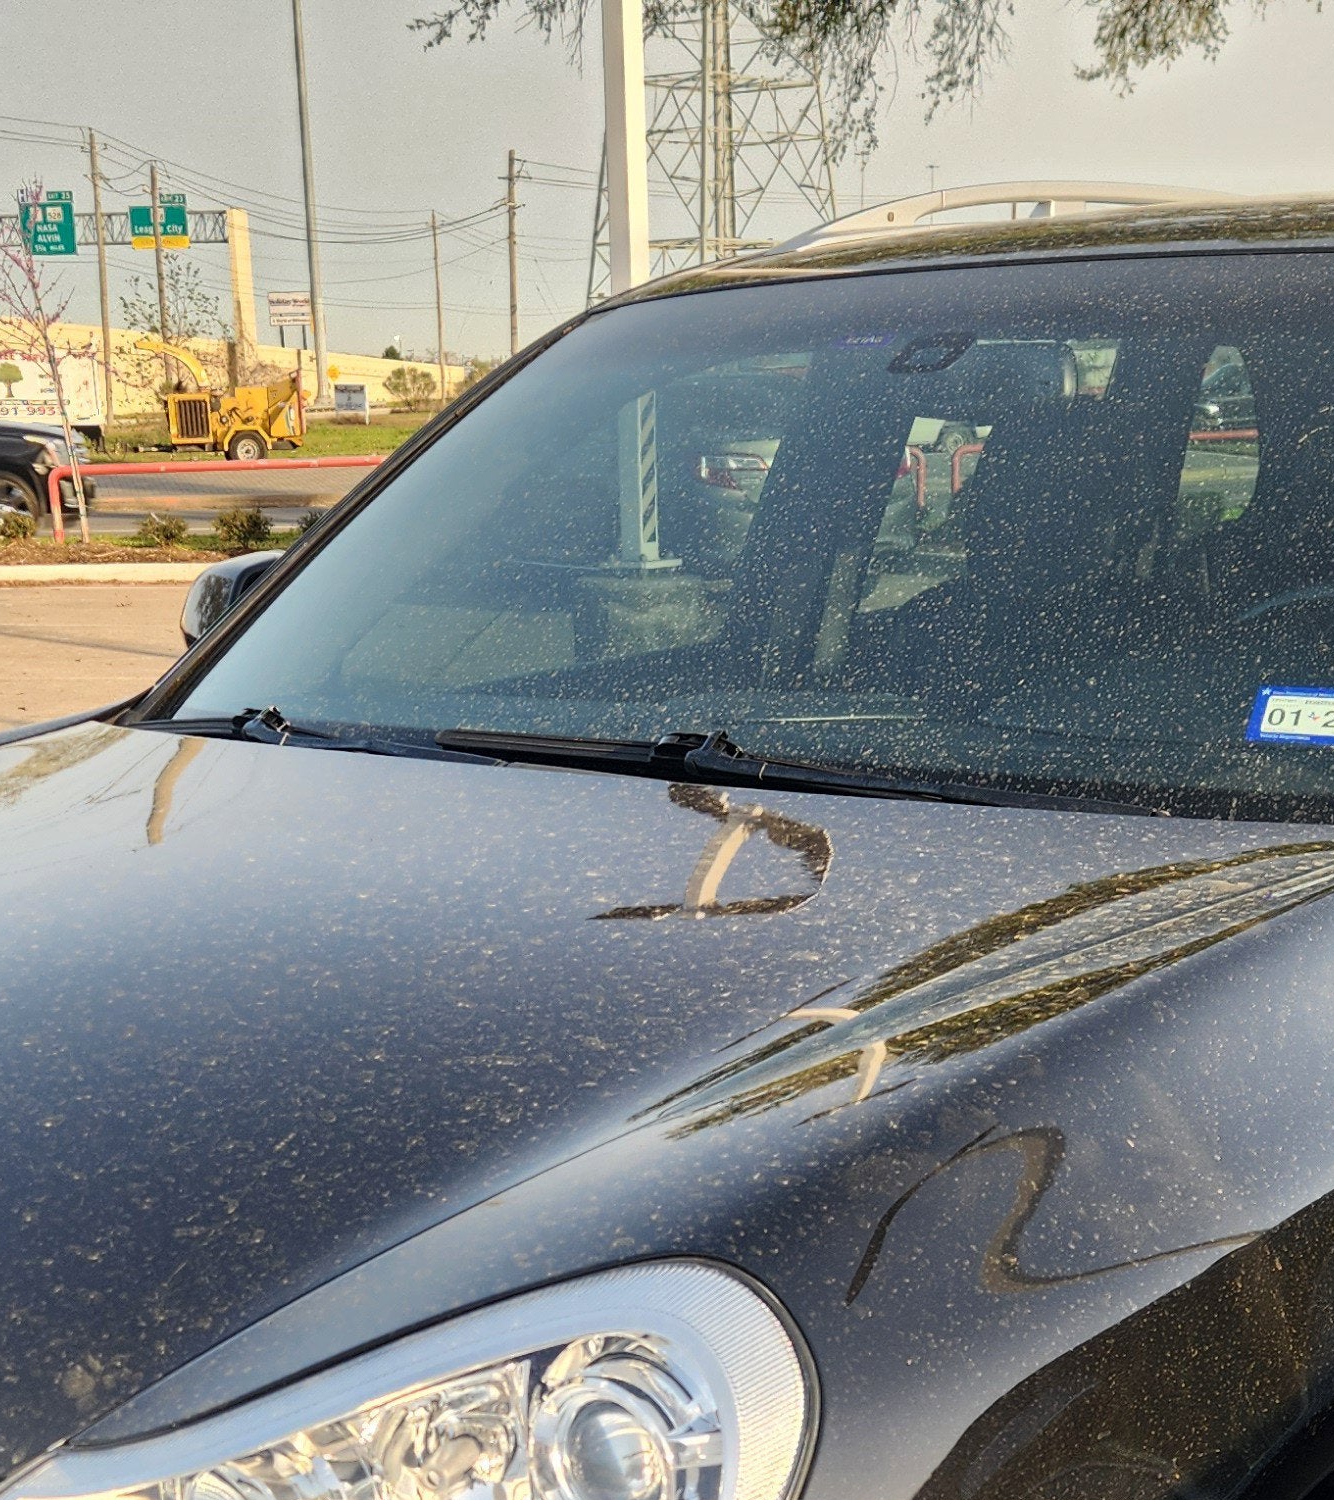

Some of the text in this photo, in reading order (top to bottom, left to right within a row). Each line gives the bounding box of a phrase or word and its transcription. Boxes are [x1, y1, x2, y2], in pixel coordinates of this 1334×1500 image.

[37, 223, 58, 232] NASA
[166, 224, 184, 235] City
[1267, 708, 1303, 726] 01
